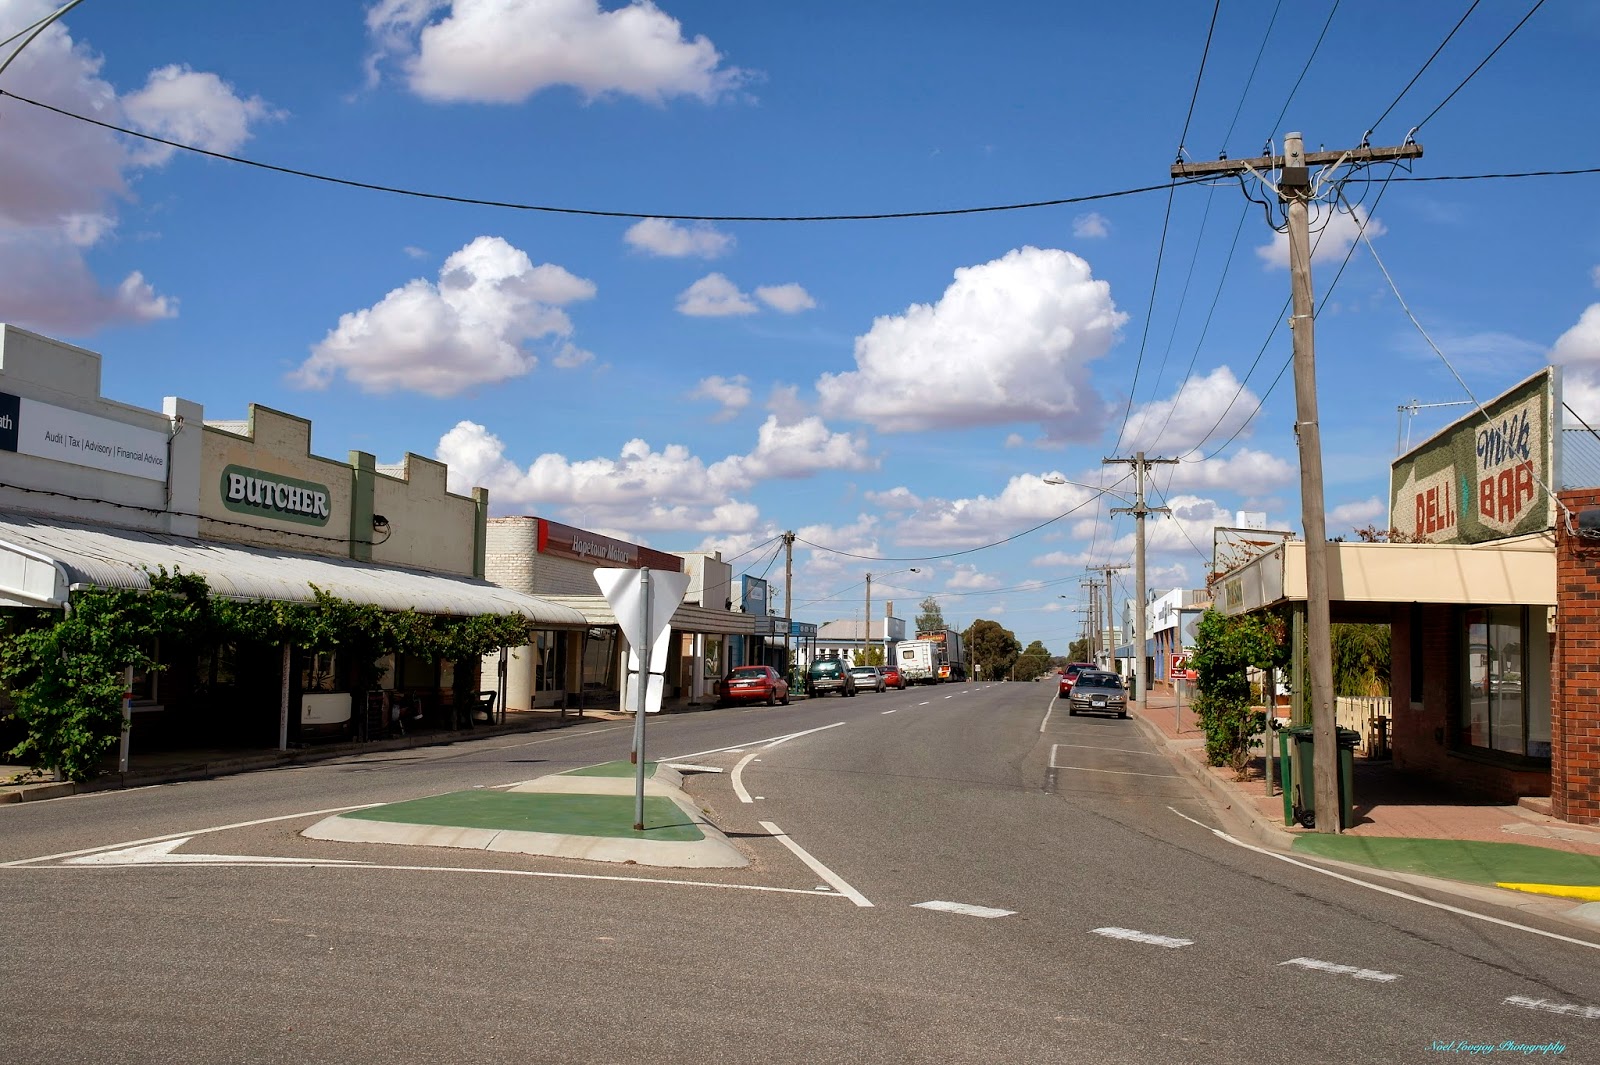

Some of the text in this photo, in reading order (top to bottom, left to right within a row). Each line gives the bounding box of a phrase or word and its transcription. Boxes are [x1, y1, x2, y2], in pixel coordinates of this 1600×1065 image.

[44, 431, 63, 444] Audit
[68, 435, 80, 448] Tax
[84, 440, 112, 457] Advisory
[116, 447, 143, 461] Financial
[144, 453, 163, 466] Advice
[227, 473, 329, 518] BUTCHER
[1480, 460, 1534, 523] BAR
[572, 535, 629, 563] Hopetoun Motors
